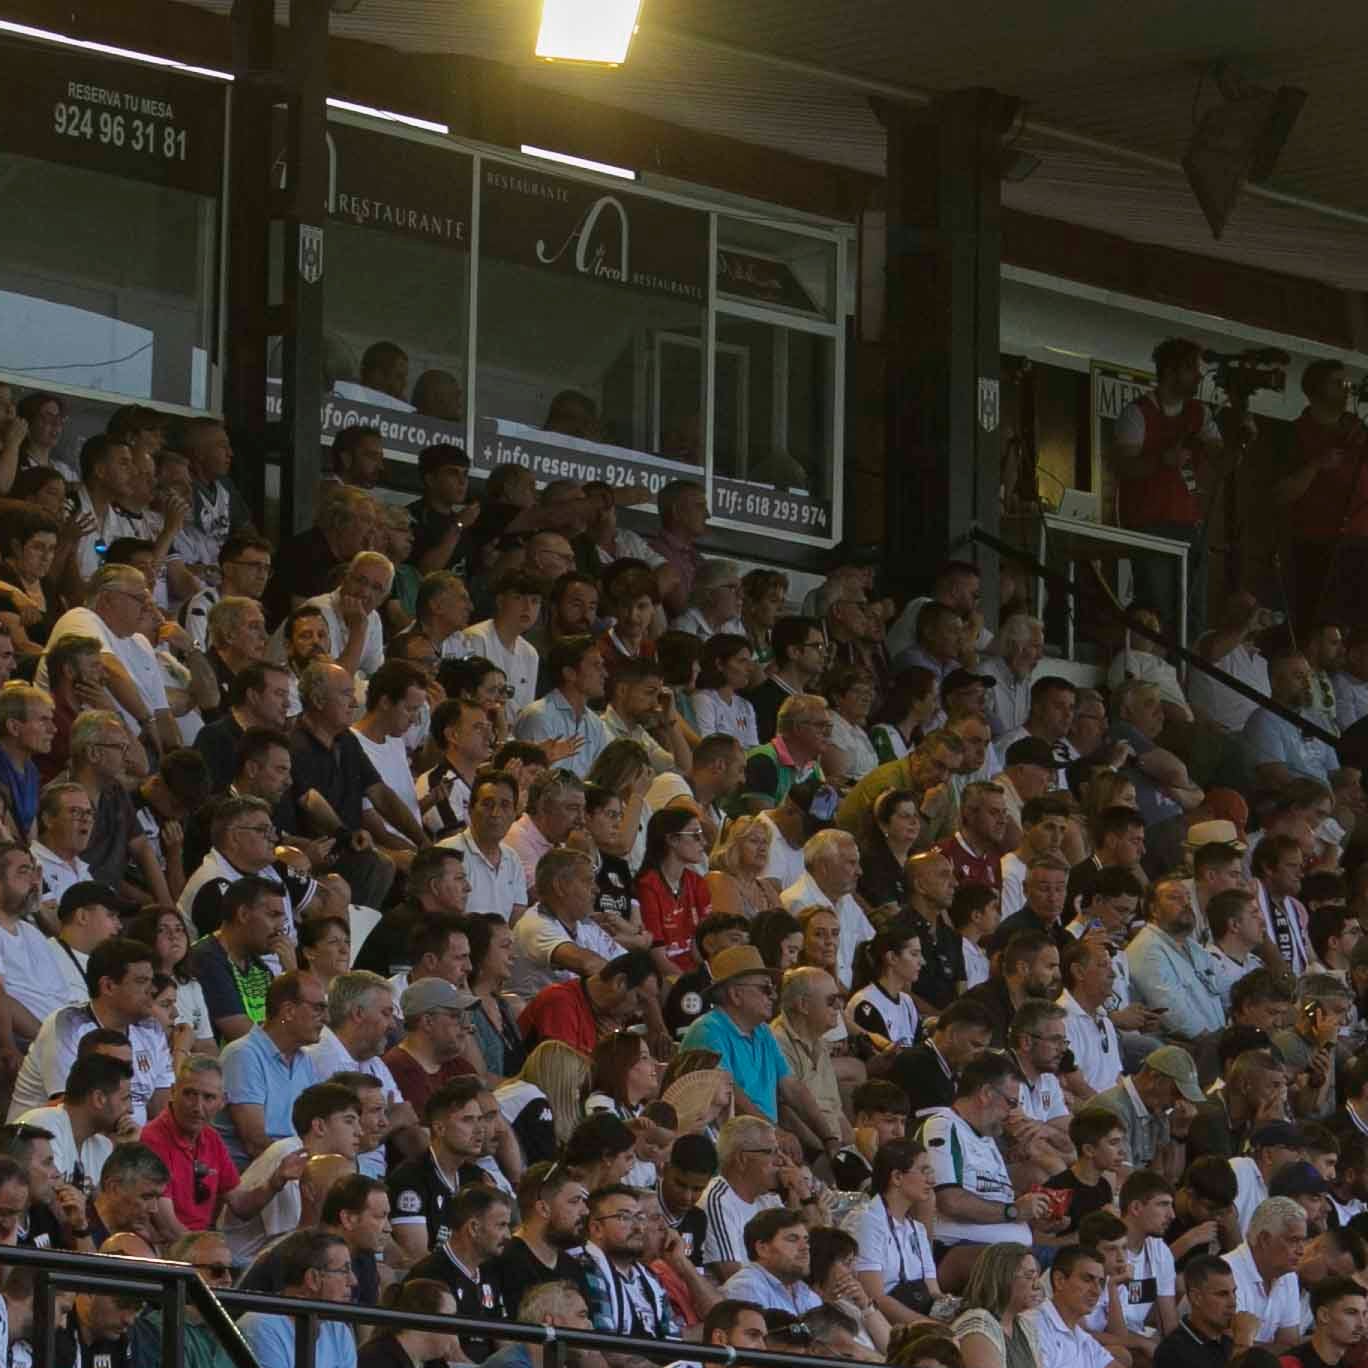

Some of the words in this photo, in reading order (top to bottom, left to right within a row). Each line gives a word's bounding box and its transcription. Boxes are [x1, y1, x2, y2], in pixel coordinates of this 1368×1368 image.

[68, 80, 121, 109] RESERVA
[123, 94, 140, 113] TU
[141, 97, 174, 121] MESA
[54, 102, 94, 140] 924
[98, 112, 126, 147] 96
[131, 119, 154, 153] 31
[163, 127, 187, 161] 81
[487, 172, 569, 205] RESTAURANTE
[338, 193, 465, 241] RESTAURANTE
[633, 273, 704, 301] RESTAURANTE
[496, 442, 530, 470] info
[533, 455, 602, 483] reserva:
[604, 464, 635, 488] 924
[717, 488, 742, 515] Tlf:
[746, 494, 770, 517] 618
[773, 499, 799, 522] 293
[801, 505, 827, 528] 974
